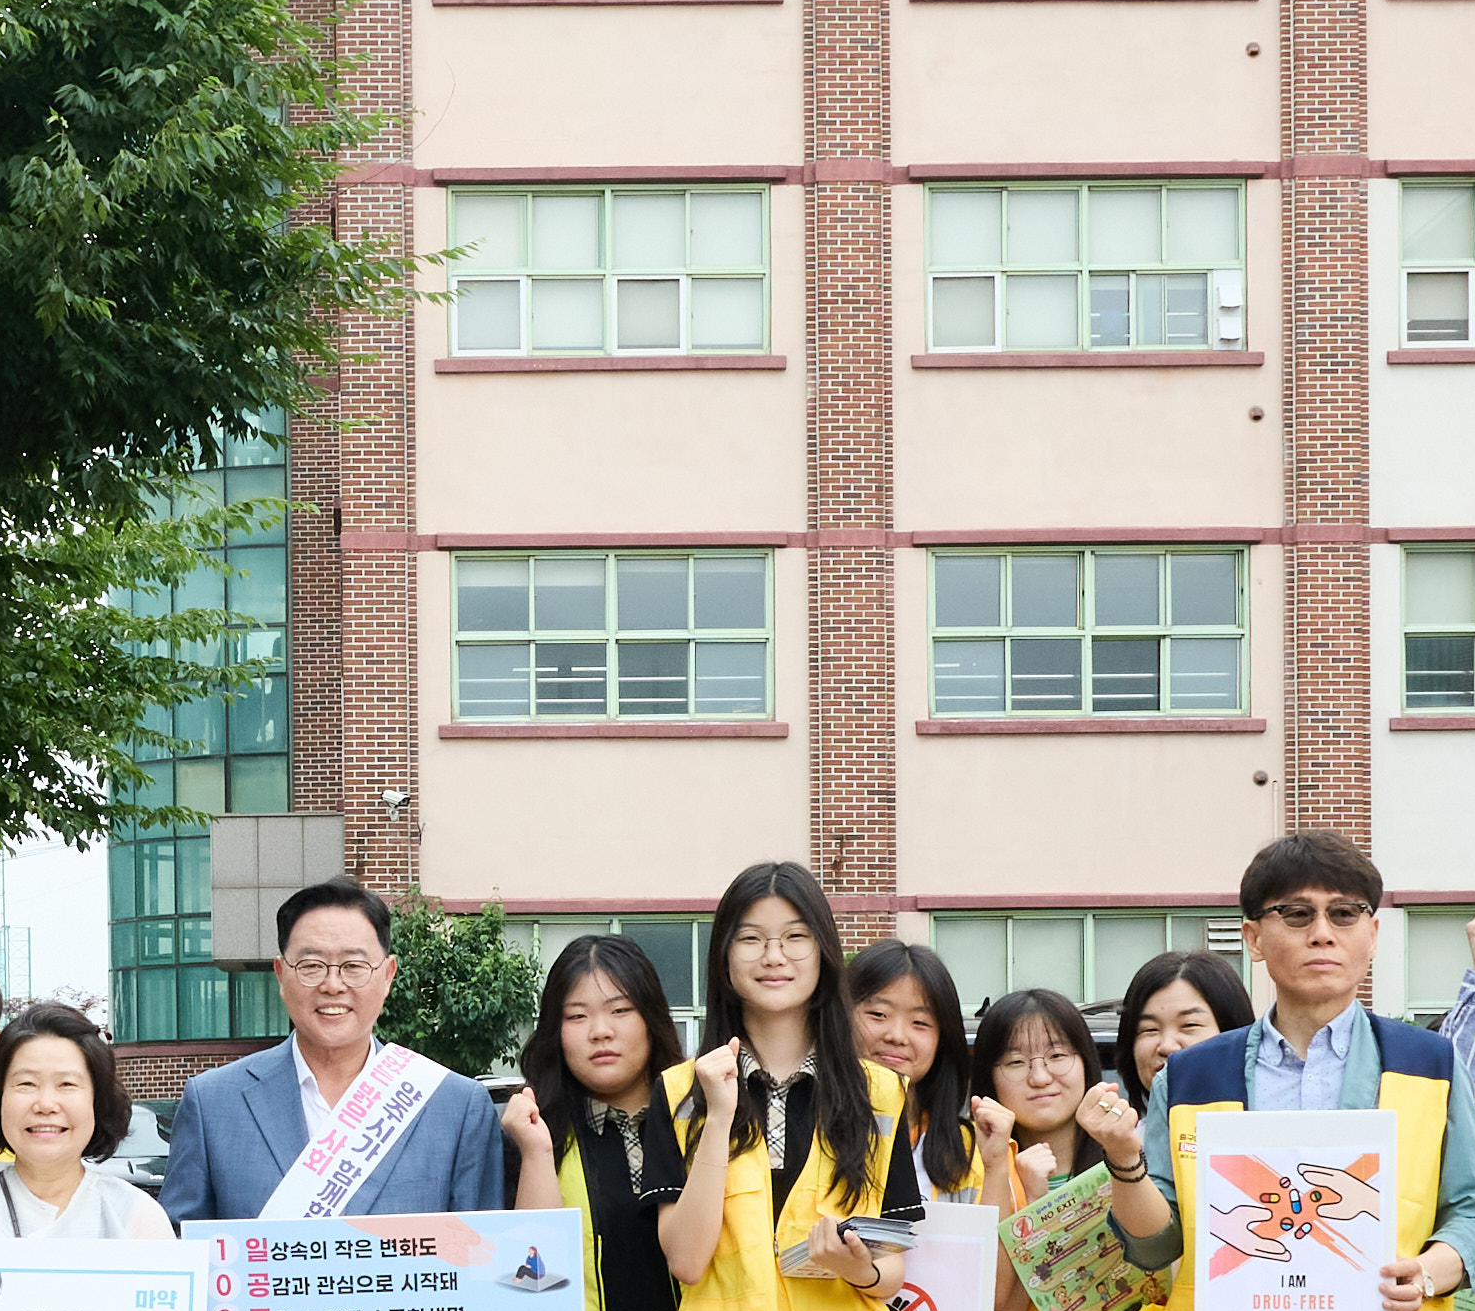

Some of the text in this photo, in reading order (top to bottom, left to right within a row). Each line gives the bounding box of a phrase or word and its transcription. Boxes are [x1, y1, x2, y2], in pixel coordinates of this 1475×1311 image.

[351, 1081, 423, 1162] 양주시가
[303, 1129, 349, 1176] 사회
[1040, 1211, 1054, 1223] NO
[1057, 1197, 1077, 1214] EXIT
[245, 1237, 327, 1262] 일상속의
[335, 1239, 373, 1259] 작은
[379, 1237, 438, 1258] 변화도
[247, 1272, 310, 1298] 공감과
[316, 1274, 393, 1296] 관심으로
[401, 1272, 458, 1292] 시작돼
[1281, 1275, 1307, 1288] I AM
[135, 1290, 178, 1310] 마약
[1253, 1295, 1335, 1310] DRUG-FREE
